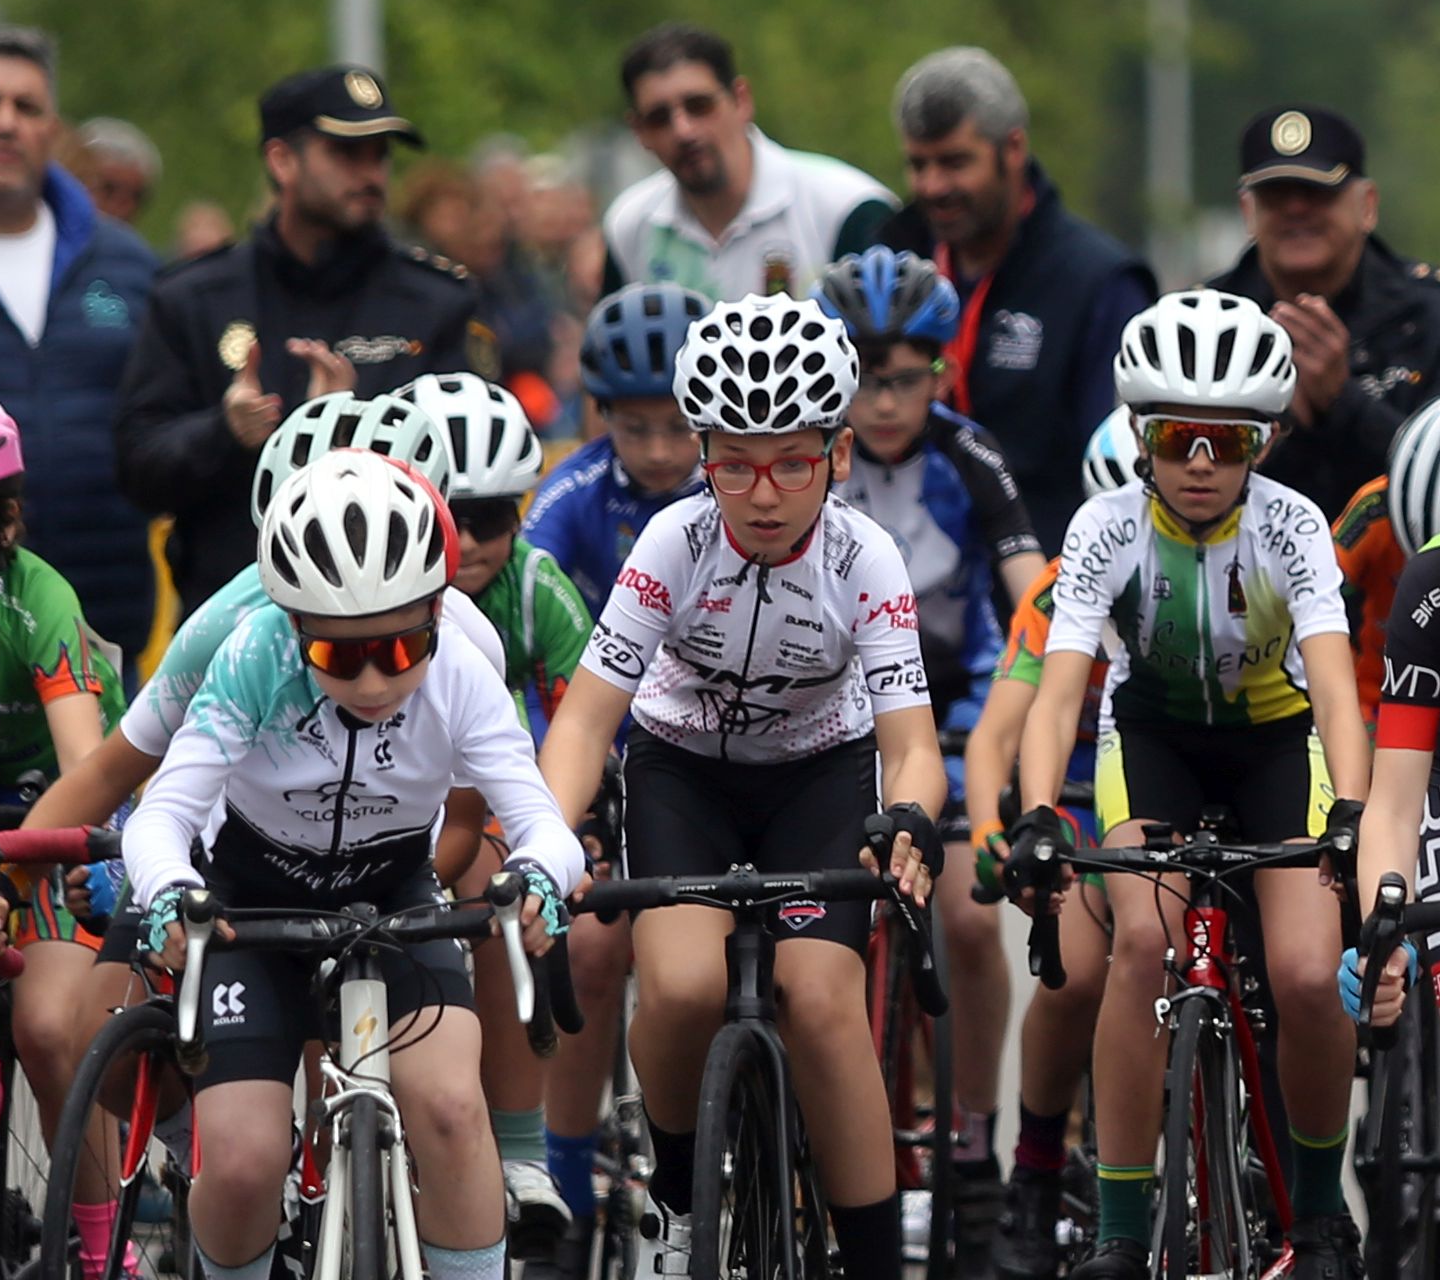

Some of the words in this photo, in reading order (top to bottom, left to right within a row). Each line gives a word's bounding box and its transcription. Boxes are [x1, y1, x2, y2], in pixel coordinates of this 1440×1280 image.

[1265, 498, 1320, 543] AYTO.
[879, 669, 923, 691] PICO
[212, 1015, 246, 1027] KOLOS
